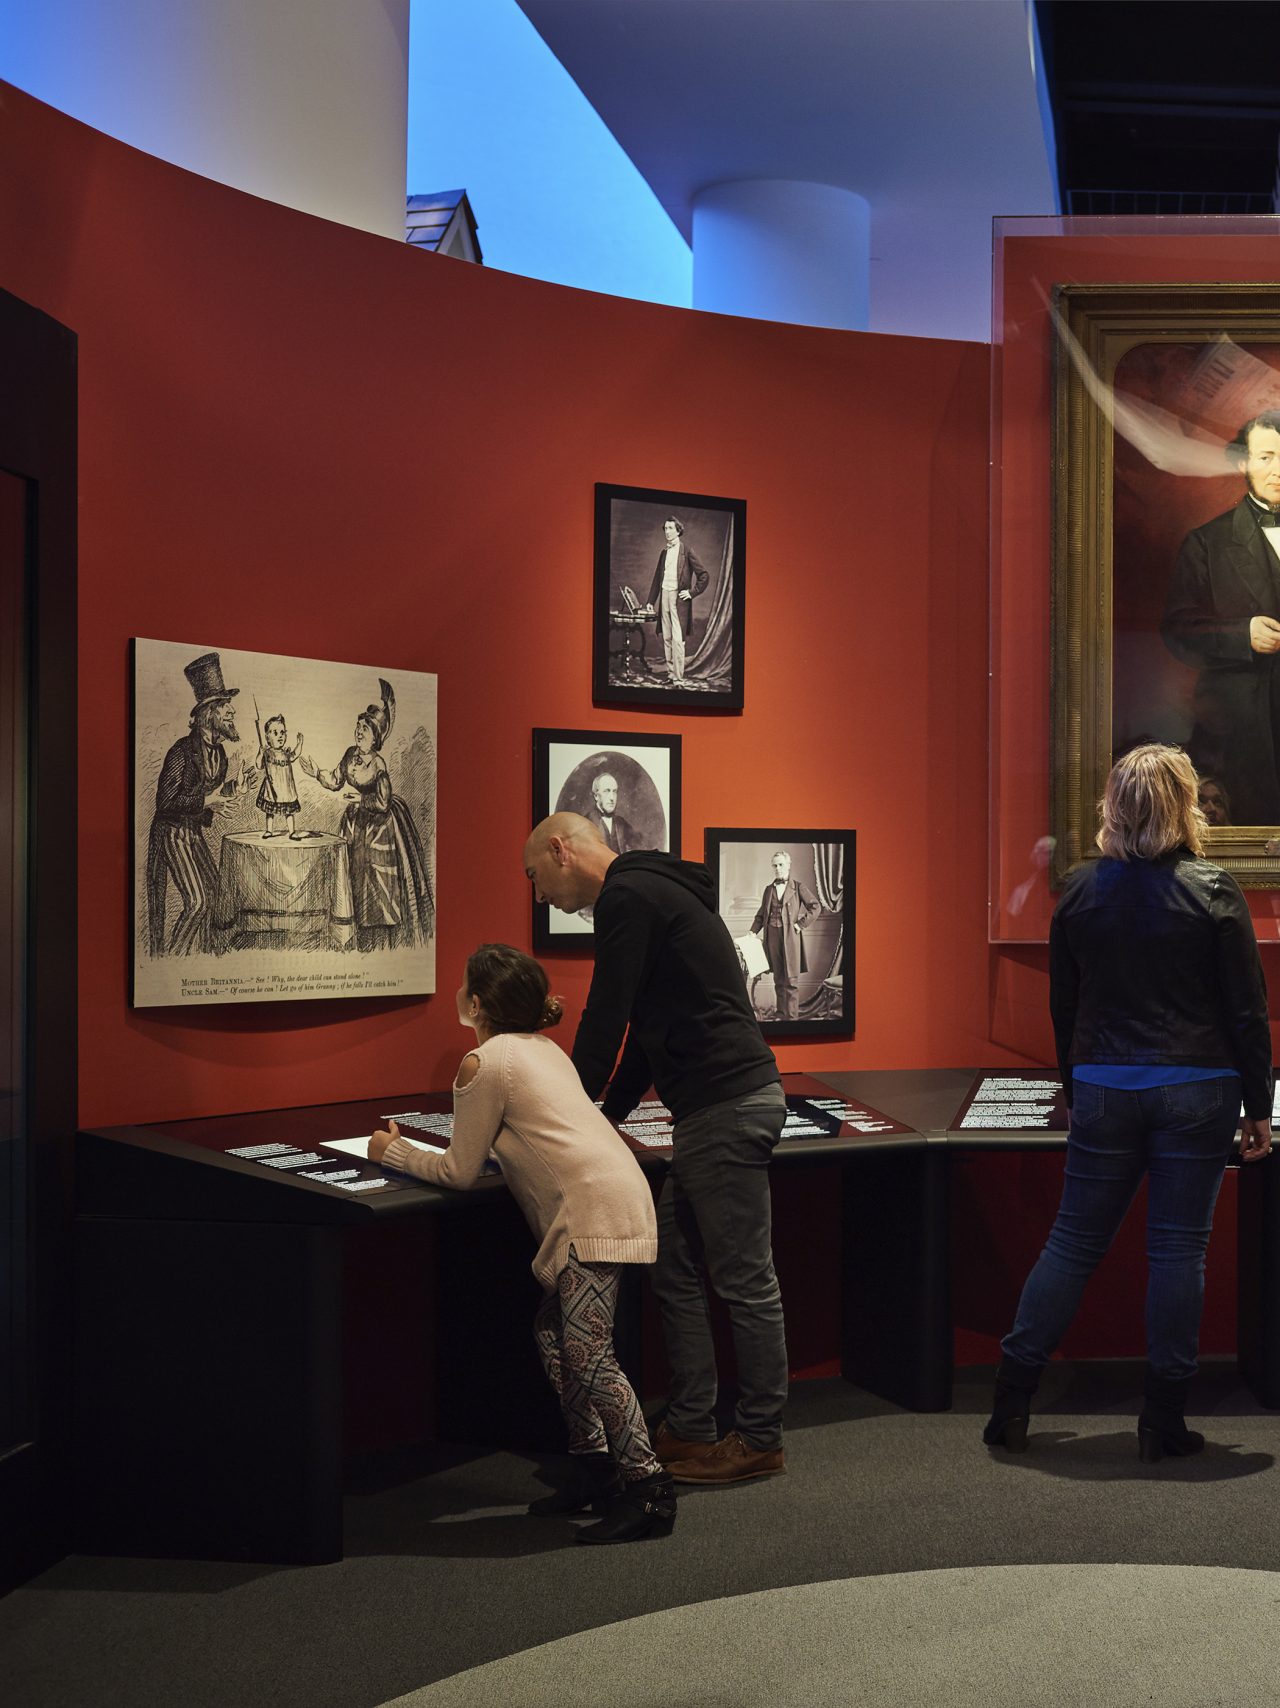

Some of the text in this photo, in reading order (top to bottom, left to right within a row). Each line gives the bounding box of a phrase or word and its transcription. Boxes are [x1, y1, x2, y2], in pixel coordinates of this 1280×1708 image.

[181, 978, 208, 987] MOTHER
[181, 988, 204, 997] UNCLE
[230, 986, 238, 996] Of
[297, 983, 304, 992] of
[304, 983, 315, 991] him
[346, 981, 352, 989] he
[352, 981, 364, 990] falls
[373, 980, 386, 988] catch
